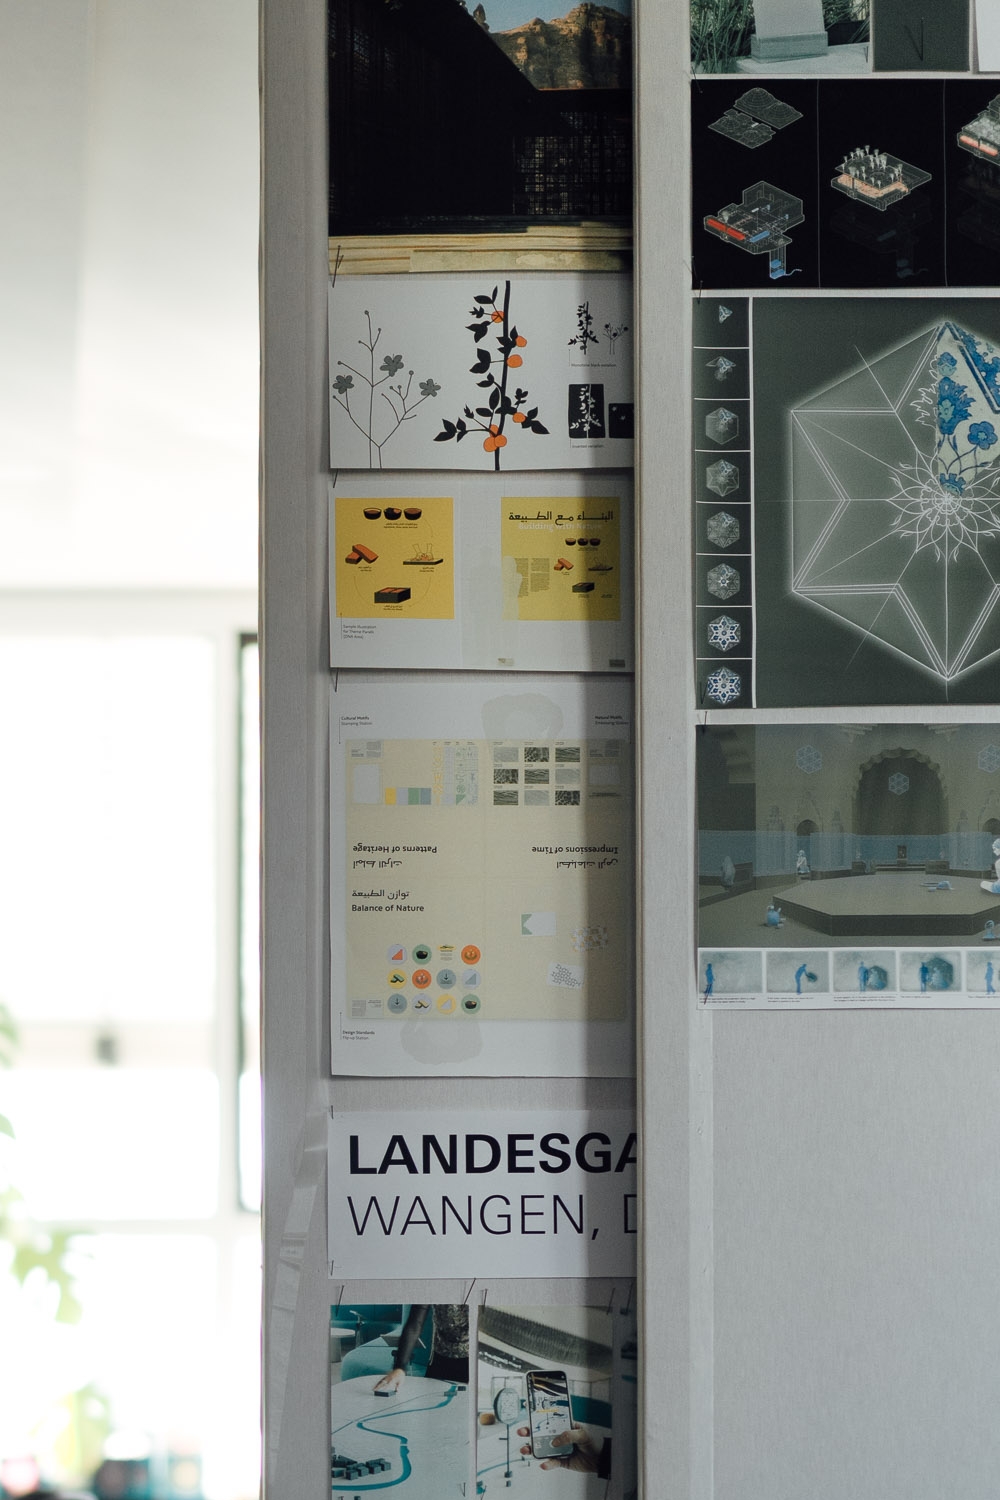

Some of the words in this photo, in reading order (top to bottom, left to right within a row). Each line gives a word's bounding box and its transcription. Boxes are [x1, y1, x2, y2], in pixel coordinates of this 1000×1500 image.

[509, 511, 552, 522] الطبيعة
[555, 514, 574, 526] مع
[519, 522, 554, 532] Building
[353, 842, 390, 854] Heritage
[391, 845, 401, 854] of
[402, 845, 438, 854] Patterns
[531, 846, 553, 855] Time
[555, 846, 564, 854] of
[565, 843, 619, 854] Impressions
[351, 889, 385, 899] الطبيعة
[387, 889, 410, 900] توازن
[351, 904, 383, 912] Balance
[384, 904, 394, 912] of
[396, 904, 425, 912] Nature
[346, 1193, 600, 1241] WANGEN,
